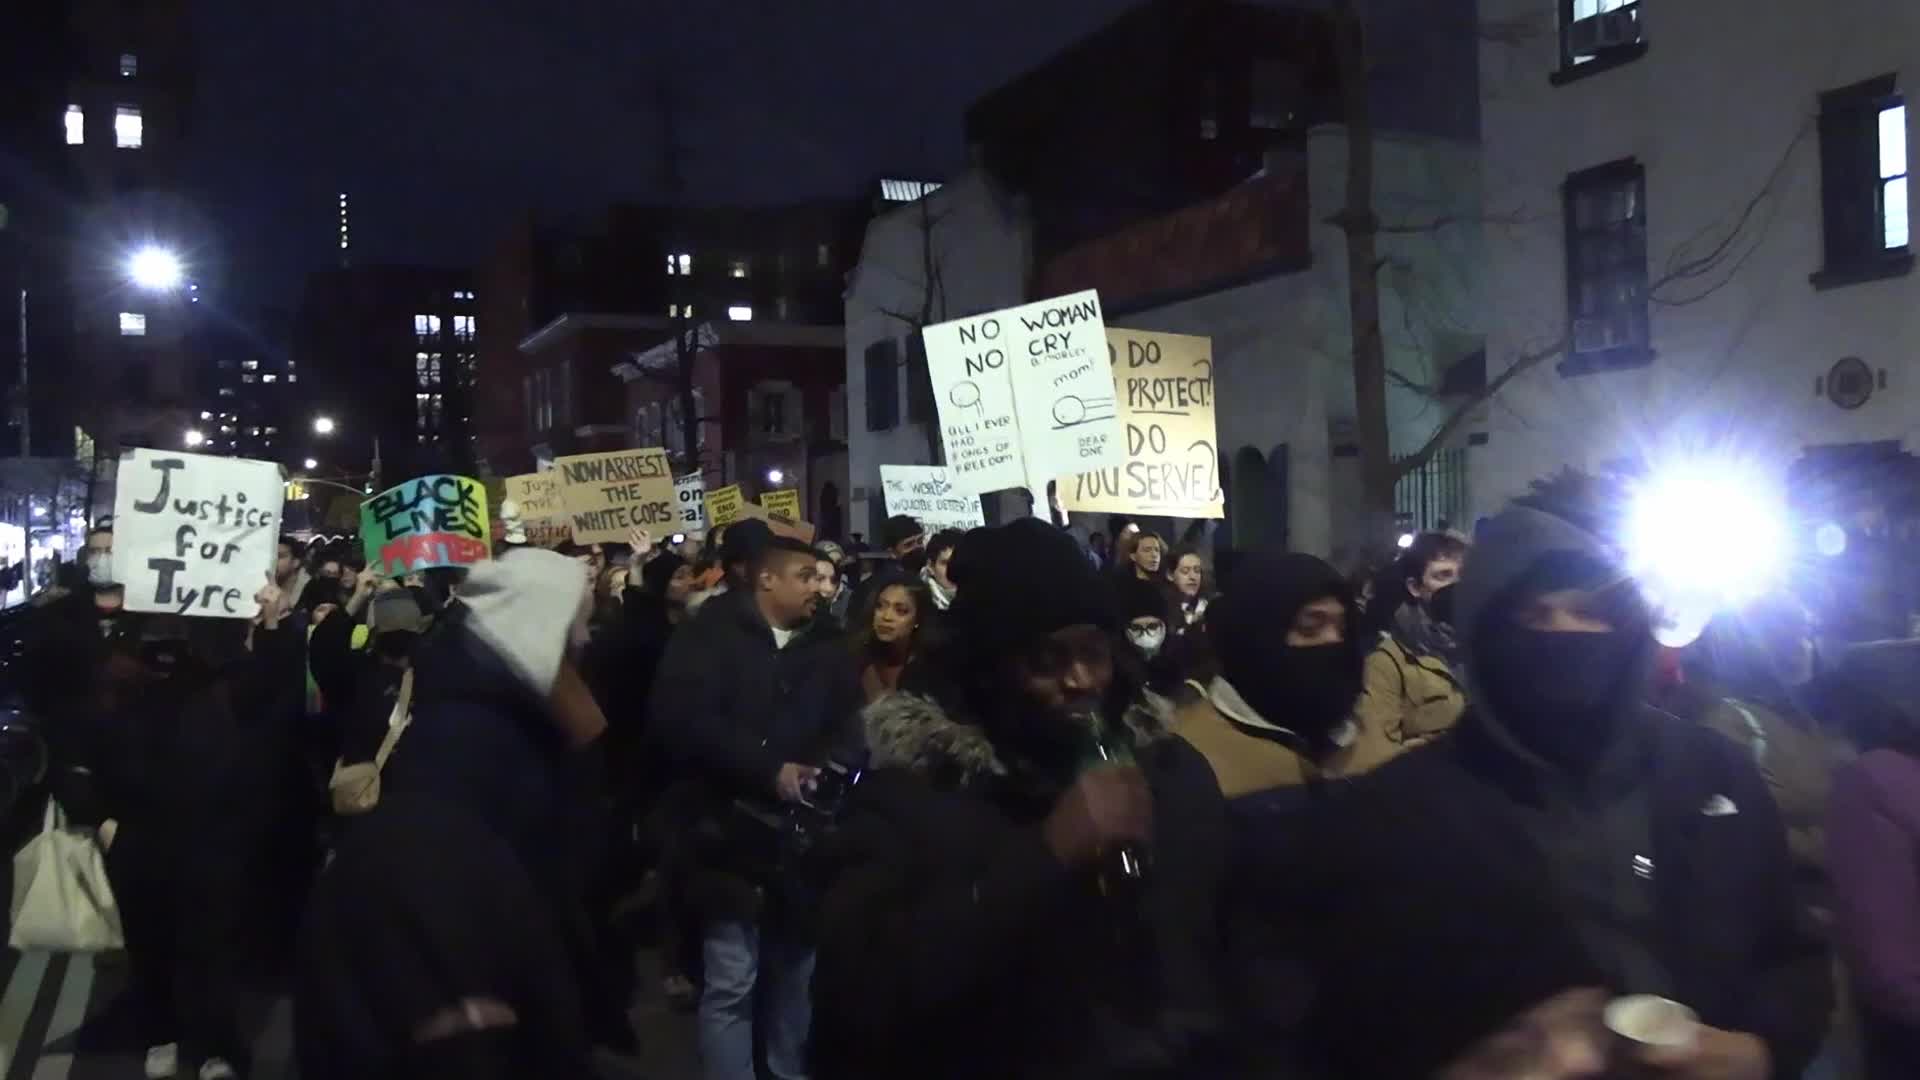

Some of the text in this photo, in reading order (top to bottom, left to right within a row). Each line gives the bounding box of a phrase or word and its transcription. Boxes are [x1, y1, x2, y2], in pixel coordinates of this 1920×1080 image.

[959, 300, 1097, 345] NO WOMAN
[966, 331, 1071, 377] NO CRY
[1128, 340, 1161, 368] DO
[1078, 434, 1108, 447] DEAR
[1079, 446, 1103, 458] ONE
[1126, 423, 1166, 456] DO
[133, 459, 273, 529] Justice
[369, 477, 480, 524] BLACK
[601, 483, 642, 503] THE
[385, 506, 483, 541] LIVES
[572, 502, 672, 533] WHITE COPS
[175, 524, 240, 564] for
[147, 558, 242, 613] Tyre
